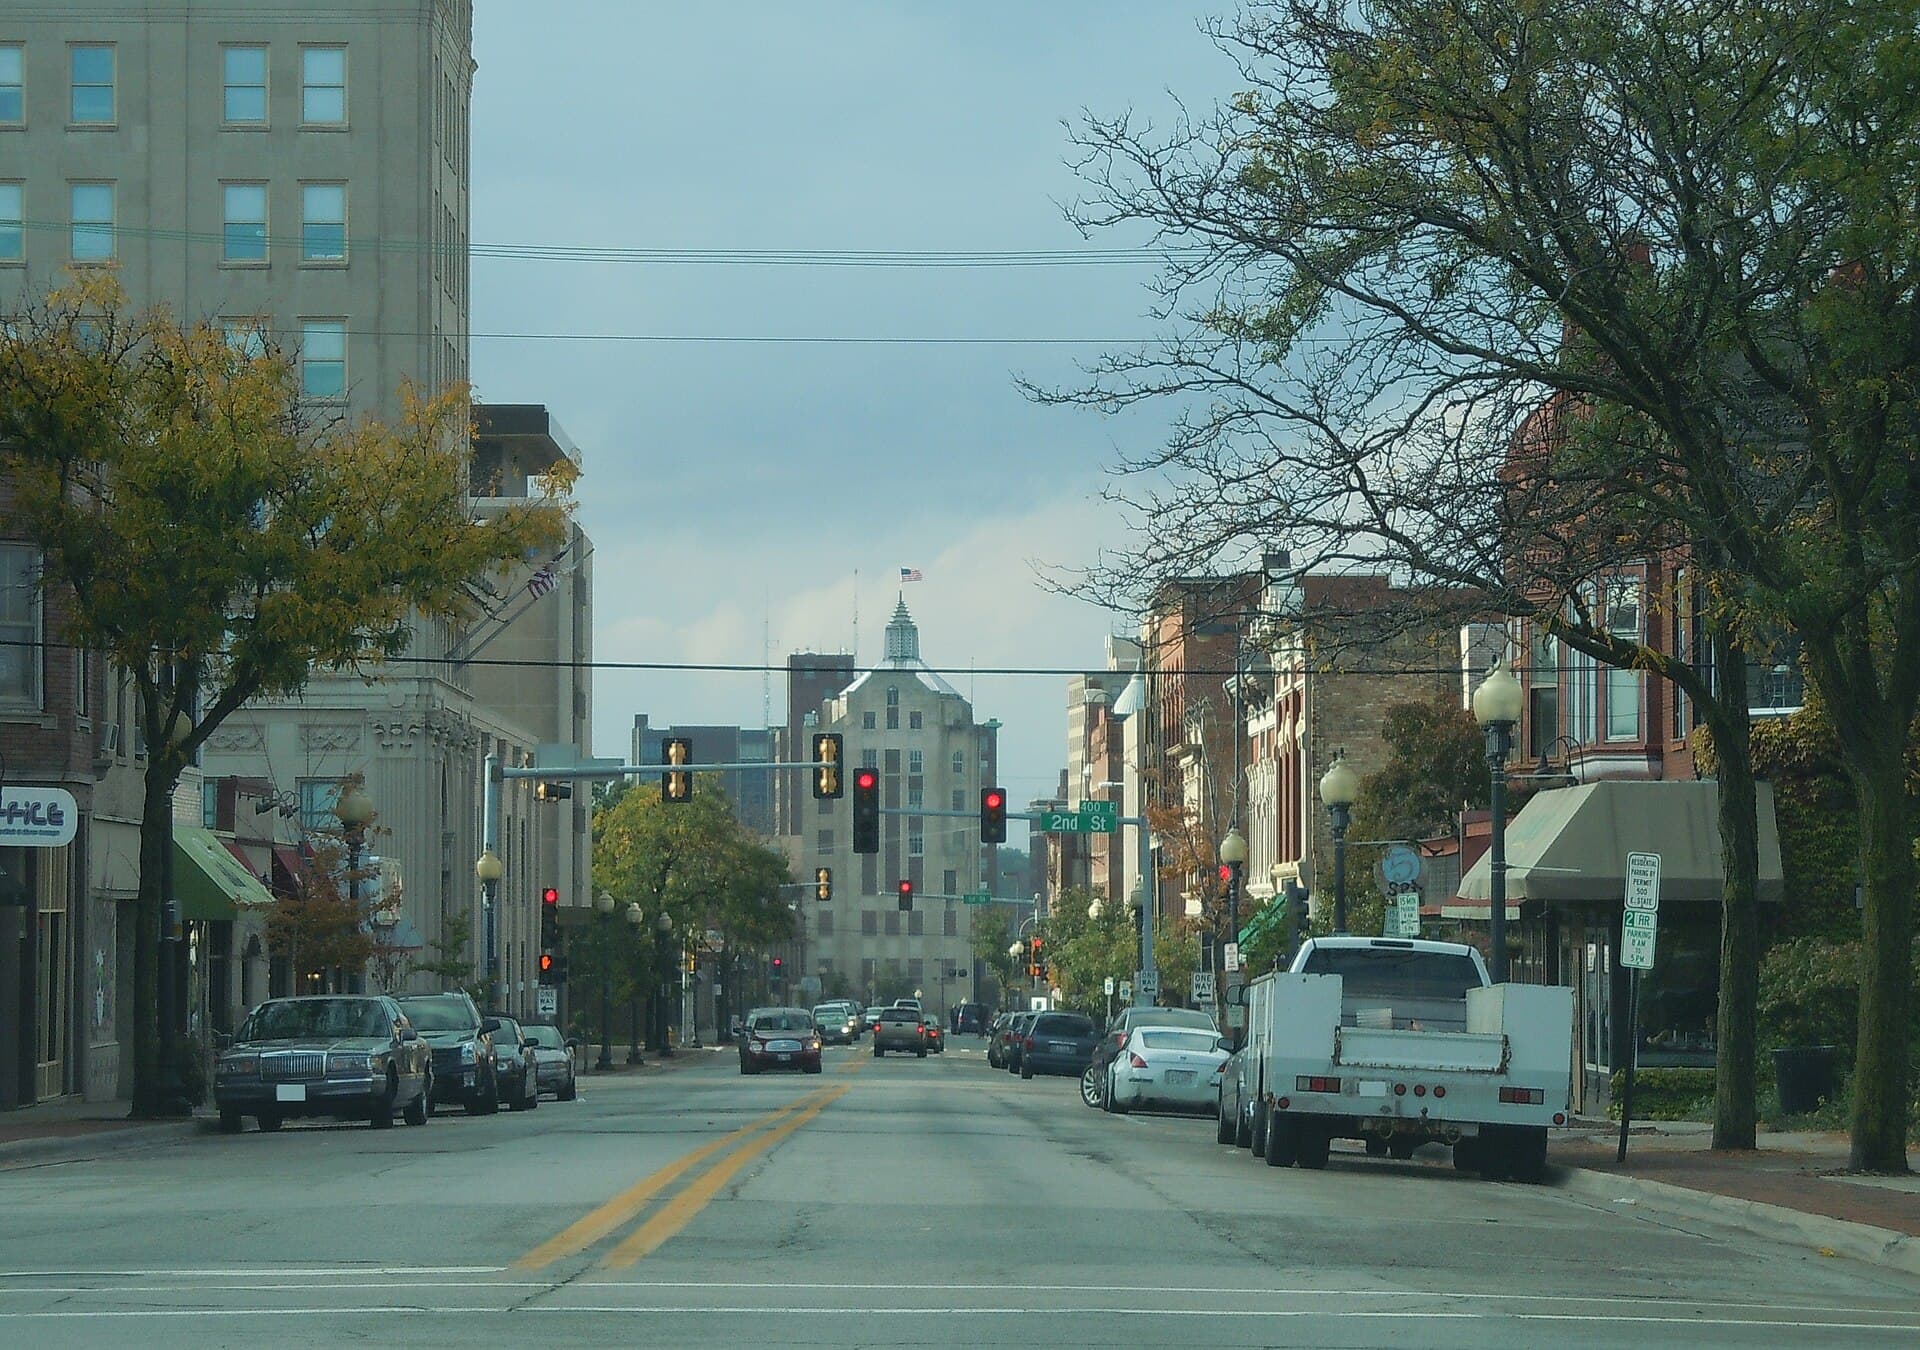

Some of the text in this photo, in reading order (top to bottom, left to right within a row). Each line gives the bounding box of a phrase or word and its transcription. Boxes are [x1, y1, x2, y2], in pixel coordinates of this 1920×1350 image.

[1081, 802, 1115, 812] 400 E
[1051, 815, 1107, 831] 2nd St
[1631, 869, 1649, 877] PARKING
[1632, 878, 1652, 887] PERMIT
[1625, 911, 1650, 926] 2 HR
[1627, 928, 1651, 939] PARKING
[1630, 953, 1645, 962] 5 PM
[1142, 971, 1155, 979] ONE
[1195, 974, 1211, 982] ONE
[540, 990, 554, 998] ONE
